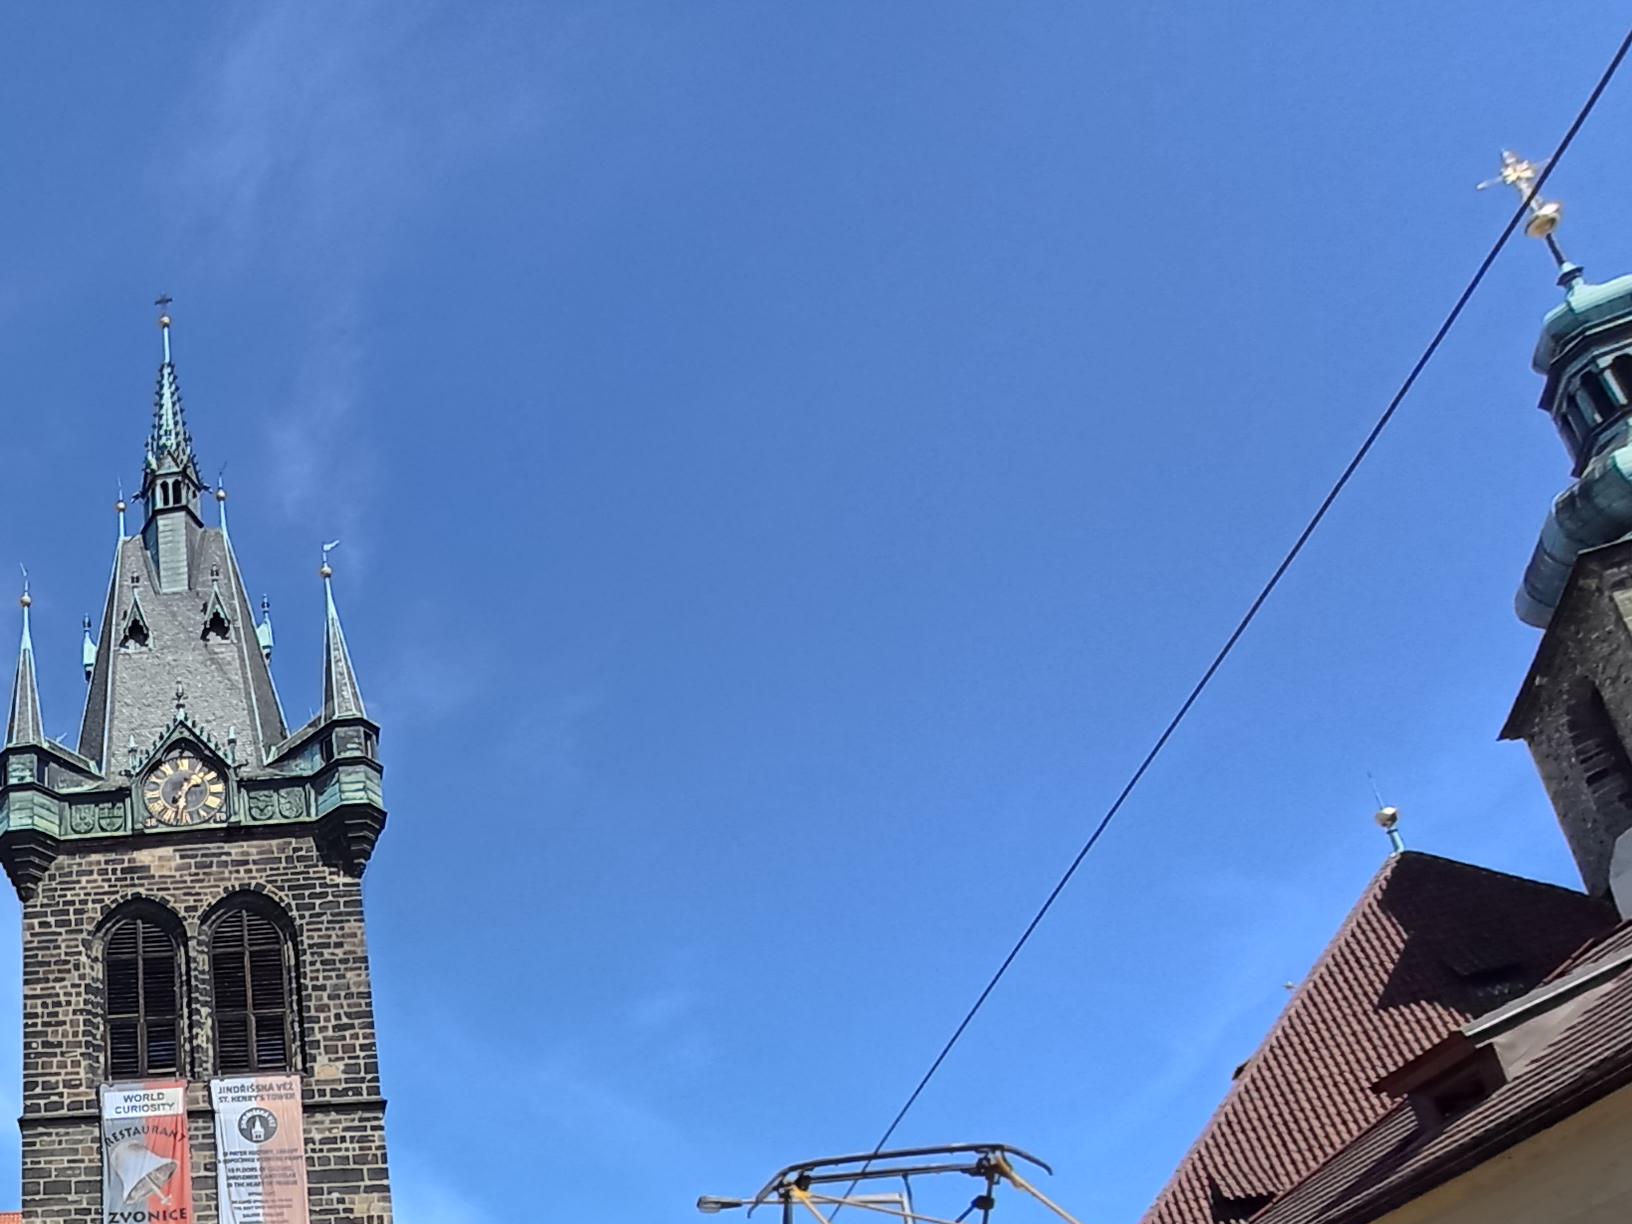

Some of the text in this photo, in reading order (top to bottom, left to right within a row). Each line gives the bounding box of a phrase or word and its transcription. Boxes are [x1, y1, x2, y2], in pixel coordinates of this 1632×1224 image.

[123, 1092, 165, 1103] WORLD
[115, 1102, 175, 1115] CURIOSITY
[108, 1208, 187, 1224] ZVONICE
